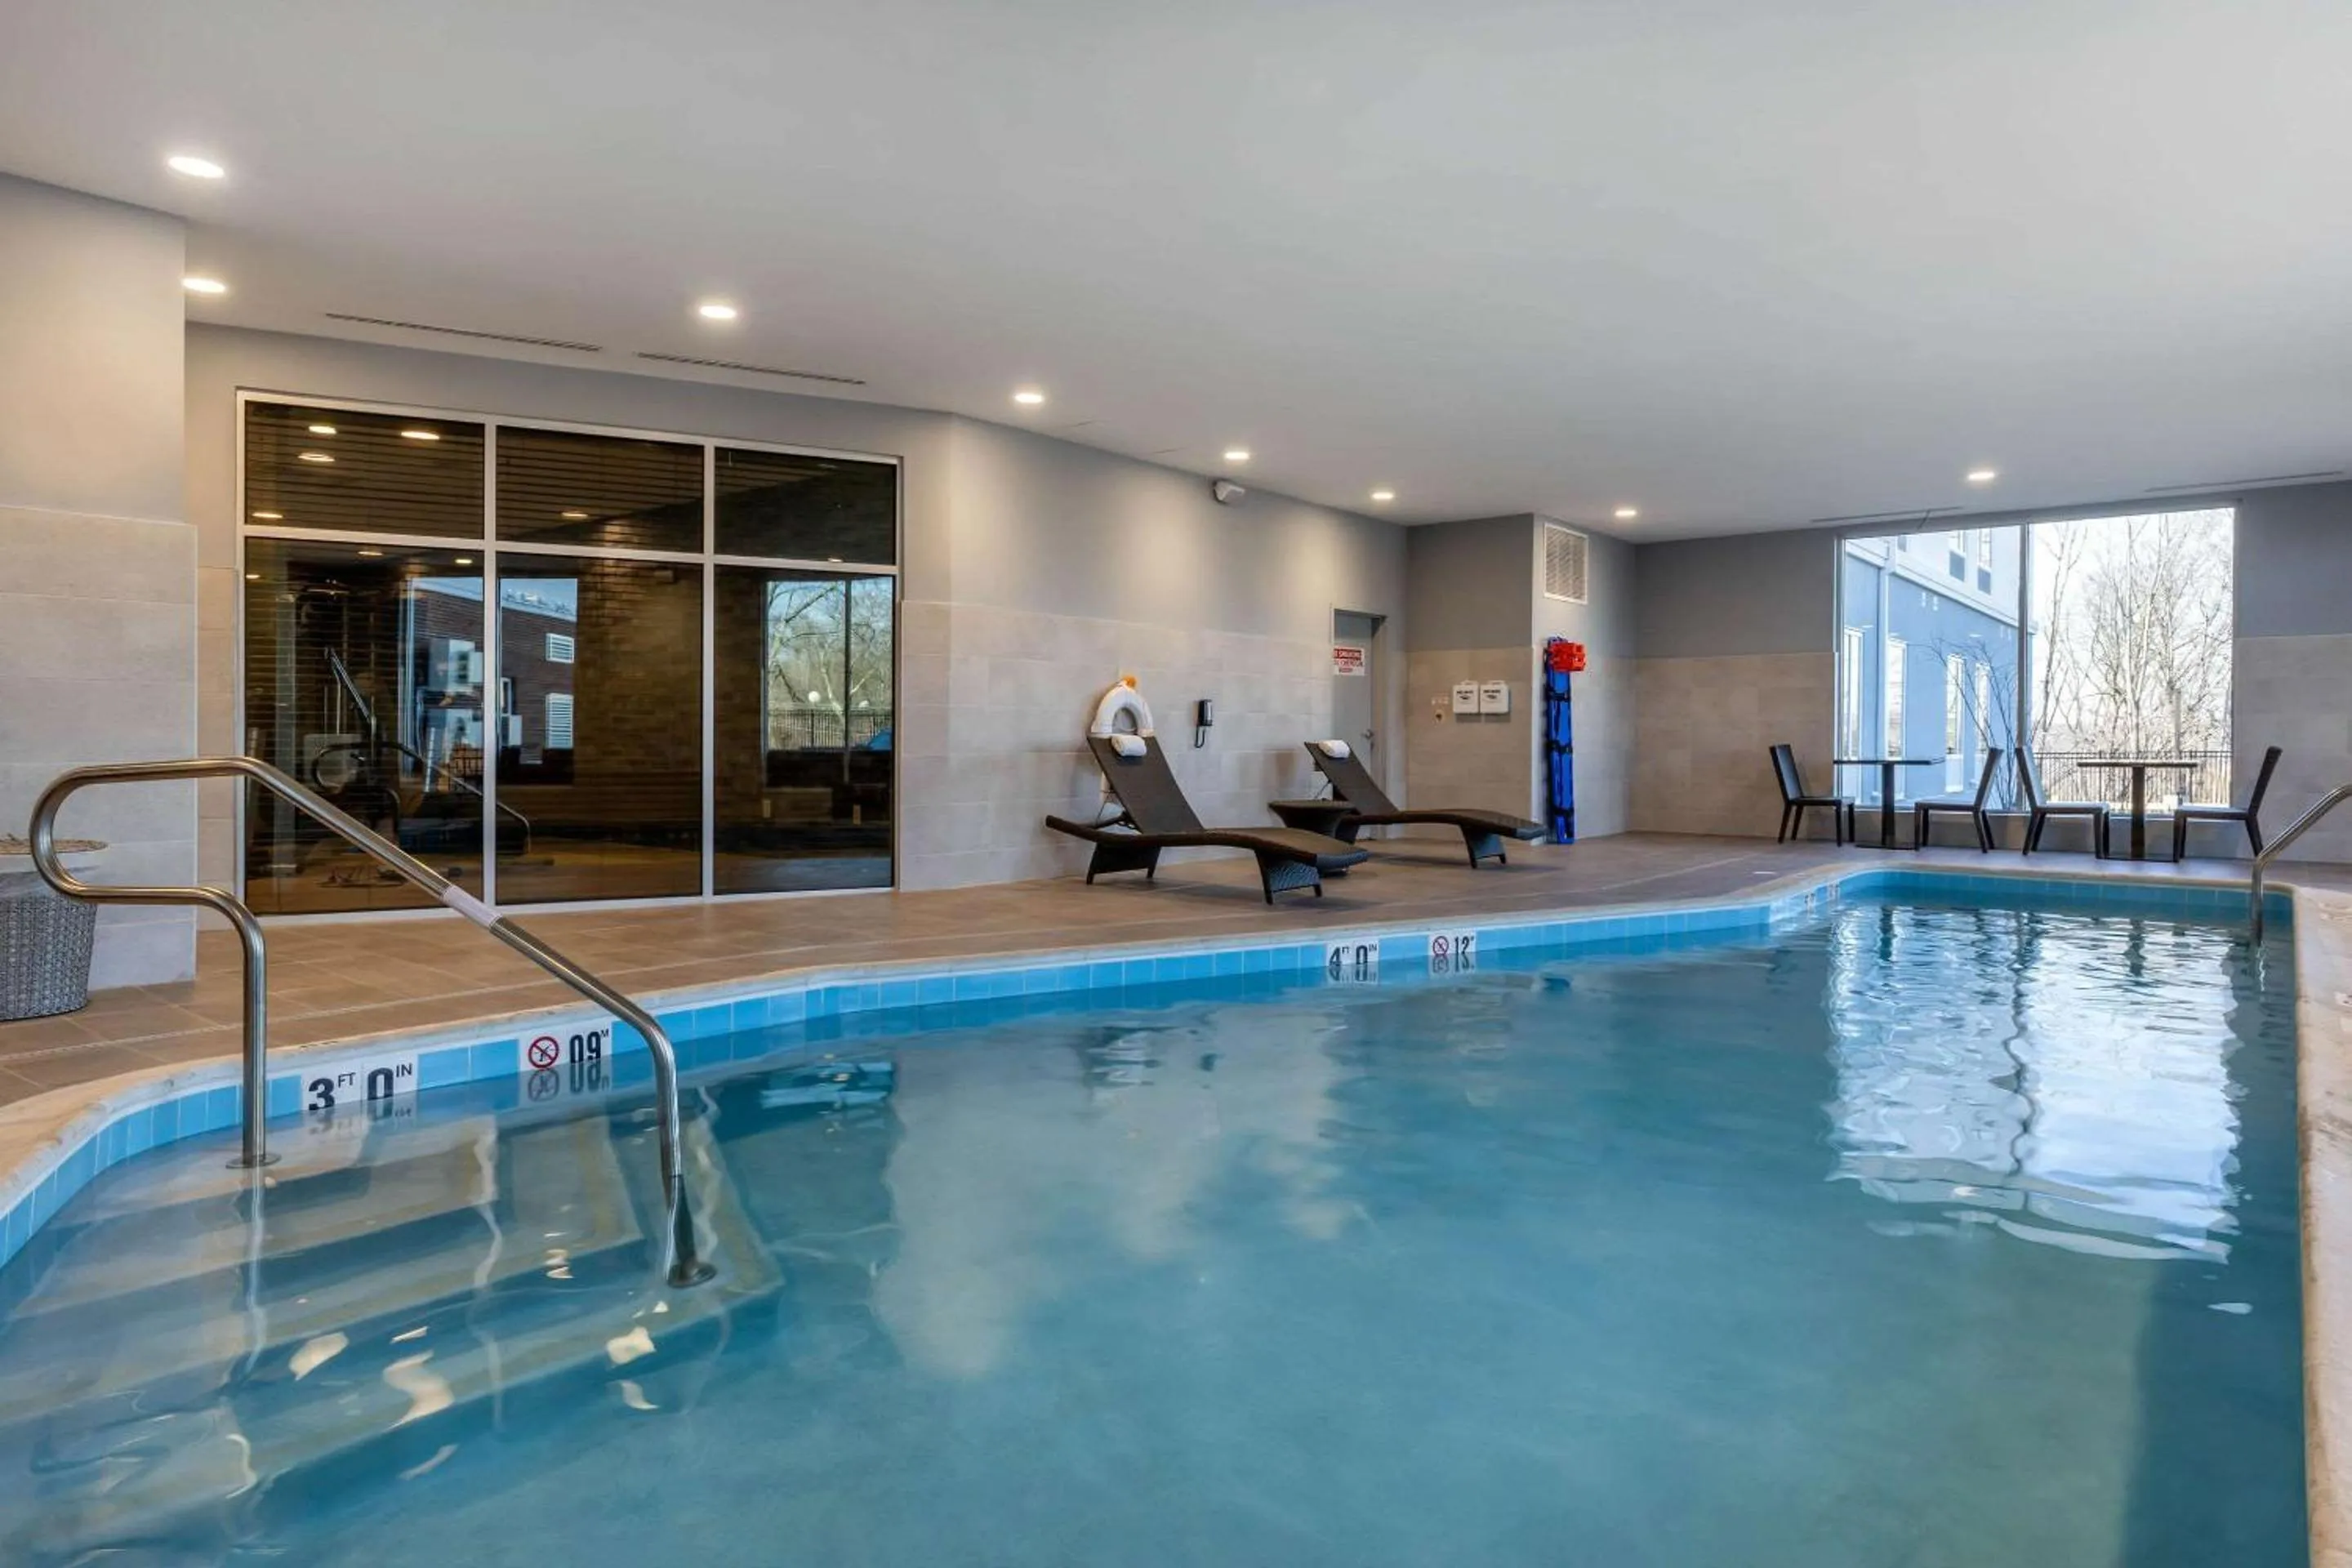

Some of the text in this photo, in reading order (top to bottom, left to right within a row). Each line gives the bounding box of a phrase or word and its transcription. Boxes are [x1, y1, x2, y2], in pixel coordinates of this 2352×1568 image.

[1329, 947, 1342, 966] 4
[309, 1062, 413, 1111] 3 FT 0 IN
